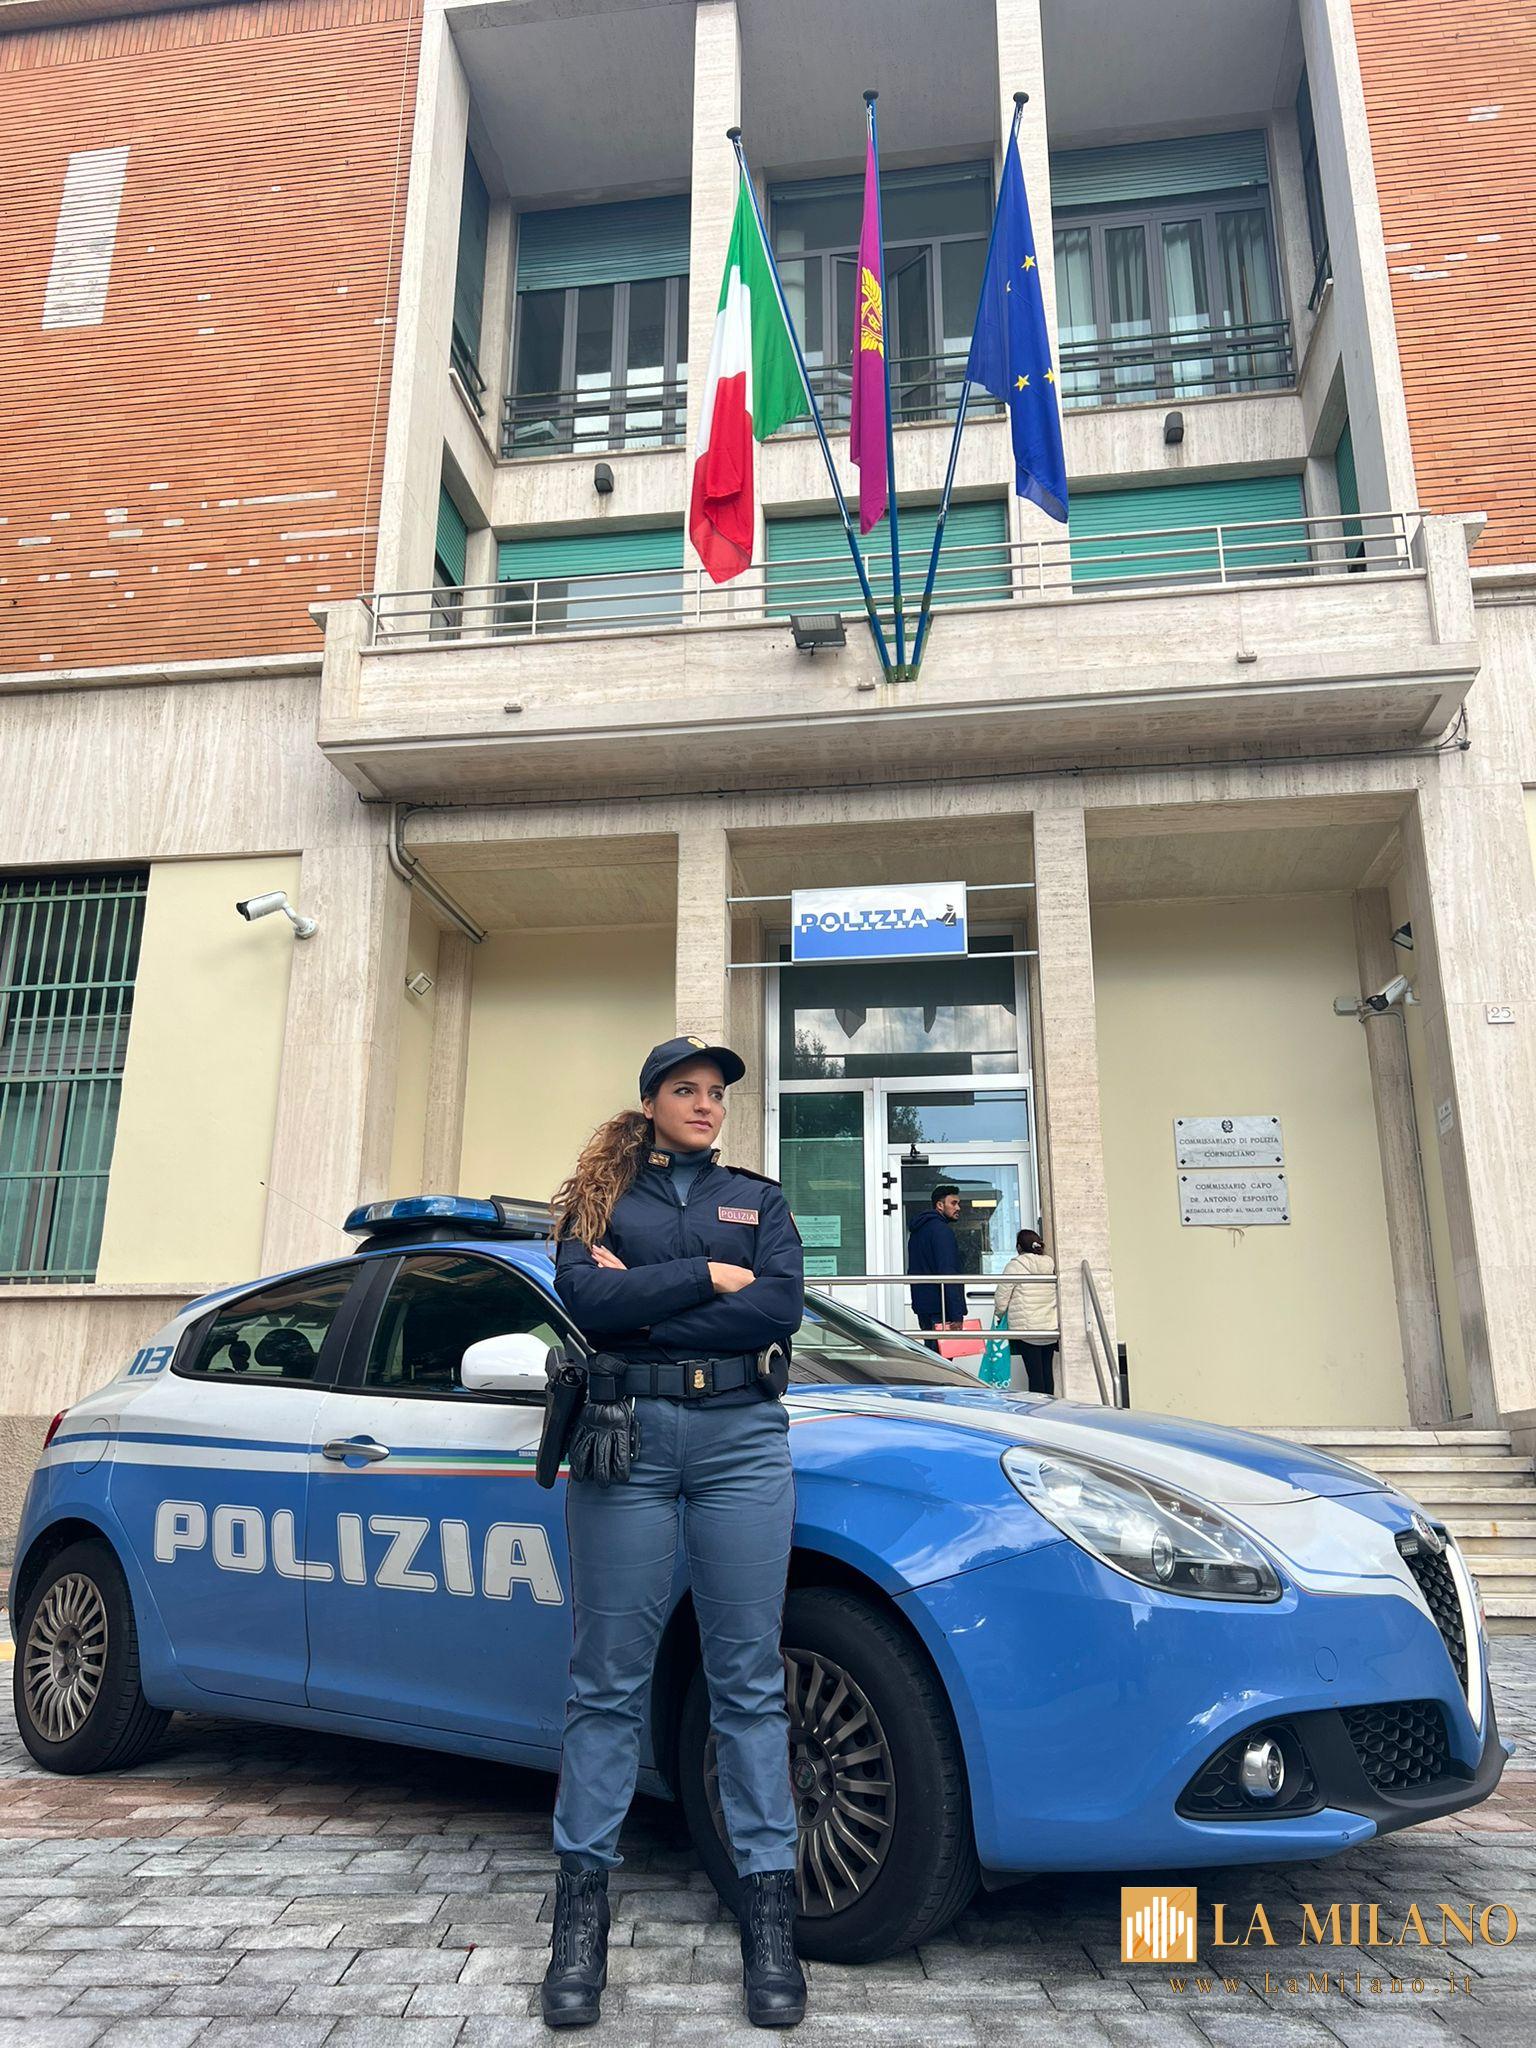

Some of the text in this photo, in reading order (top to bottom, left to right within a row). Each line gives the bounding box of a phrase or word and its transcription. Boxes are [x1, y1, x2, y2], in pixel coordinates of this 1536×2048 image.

[801, 908, 929, 934] POLIZIA
[1491, 1006, 1511, 1019] 25
[1204, 1150, 1256, 1158] CORNIGLIANO
[721, 1210, 756, 1222] POLIZIA
[127, 1345, 174, 1376] 113
[153, 1499, 565, 1606] POLIZIA
